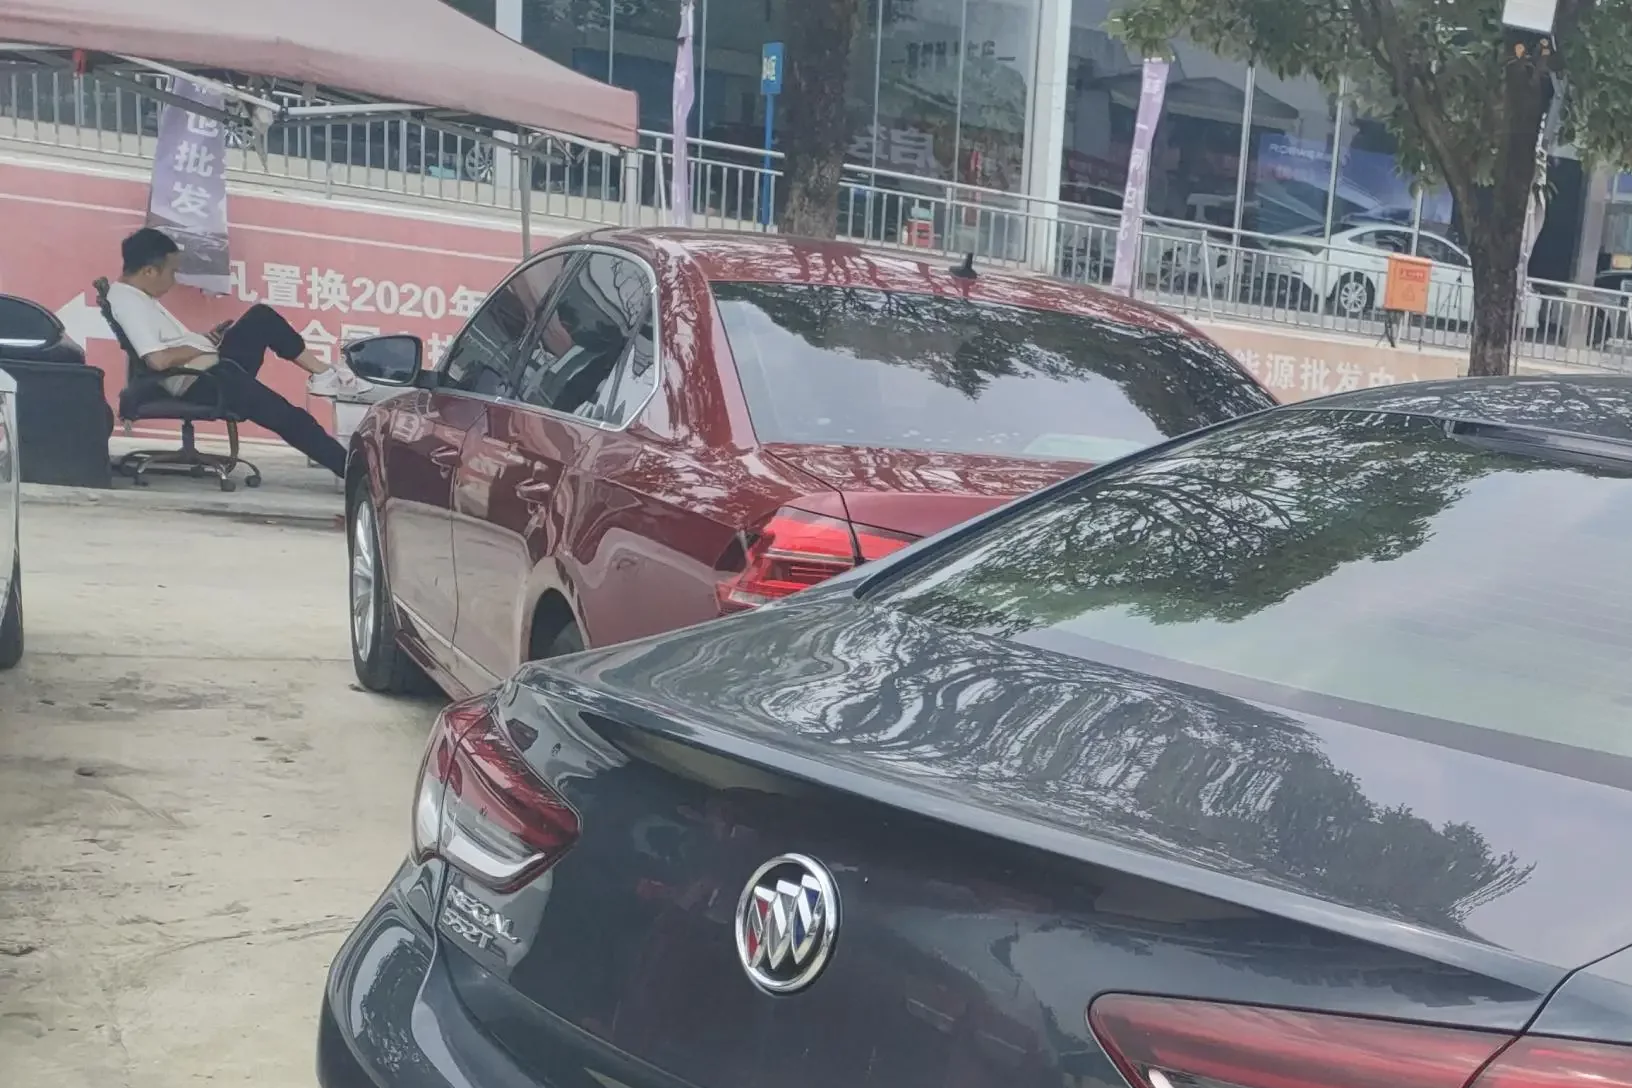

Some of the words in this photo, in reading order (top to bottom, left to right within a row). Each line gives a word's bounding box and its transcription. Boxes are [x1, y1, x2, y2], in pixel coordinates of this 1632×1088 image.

[1234, 350, 1421, 394] 能源批发中
